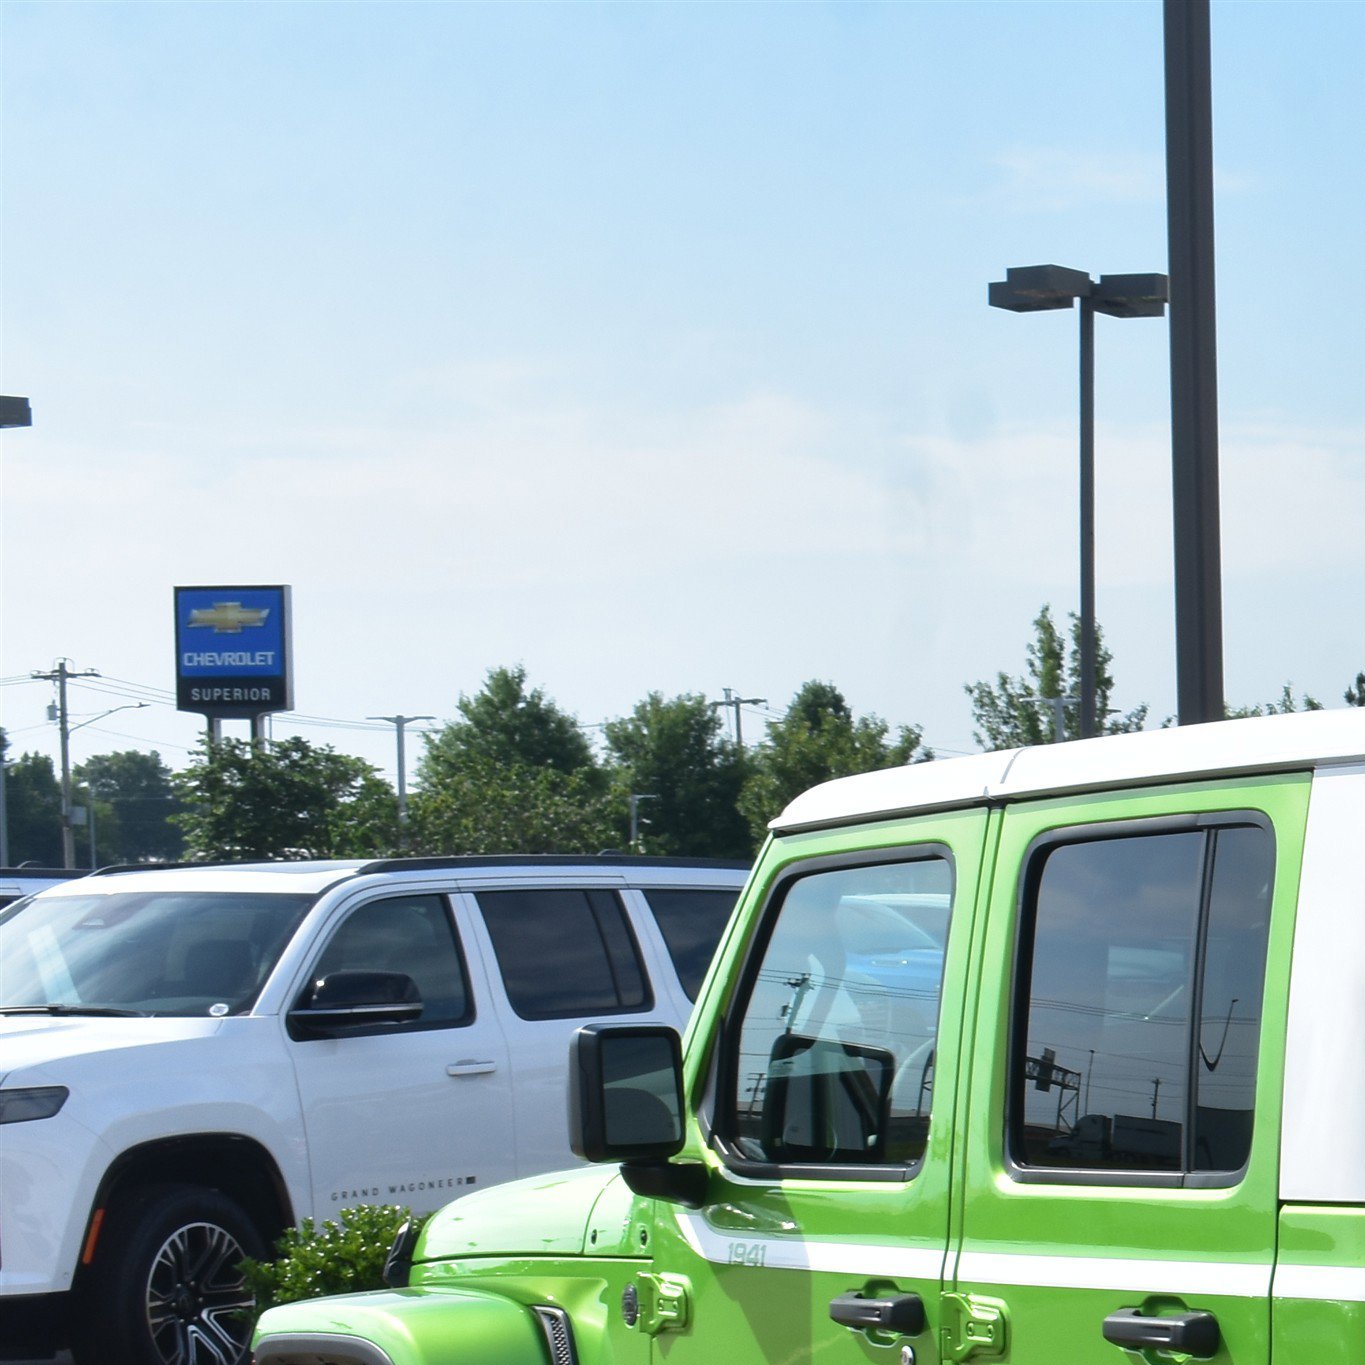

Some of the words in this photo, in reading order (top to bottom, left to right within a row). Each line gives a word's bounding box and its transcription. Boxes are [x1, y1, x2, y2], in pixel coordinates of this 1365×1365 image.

[183, 651, 275, 666] CHEVROLET
[191, 687, 271, 701] SUPERIOR
[331, 1187, 379, 1201] GRAND
[388, 1177, 464, 1195] WAGONEER
[728, 1242, 767, 1267] 1941
